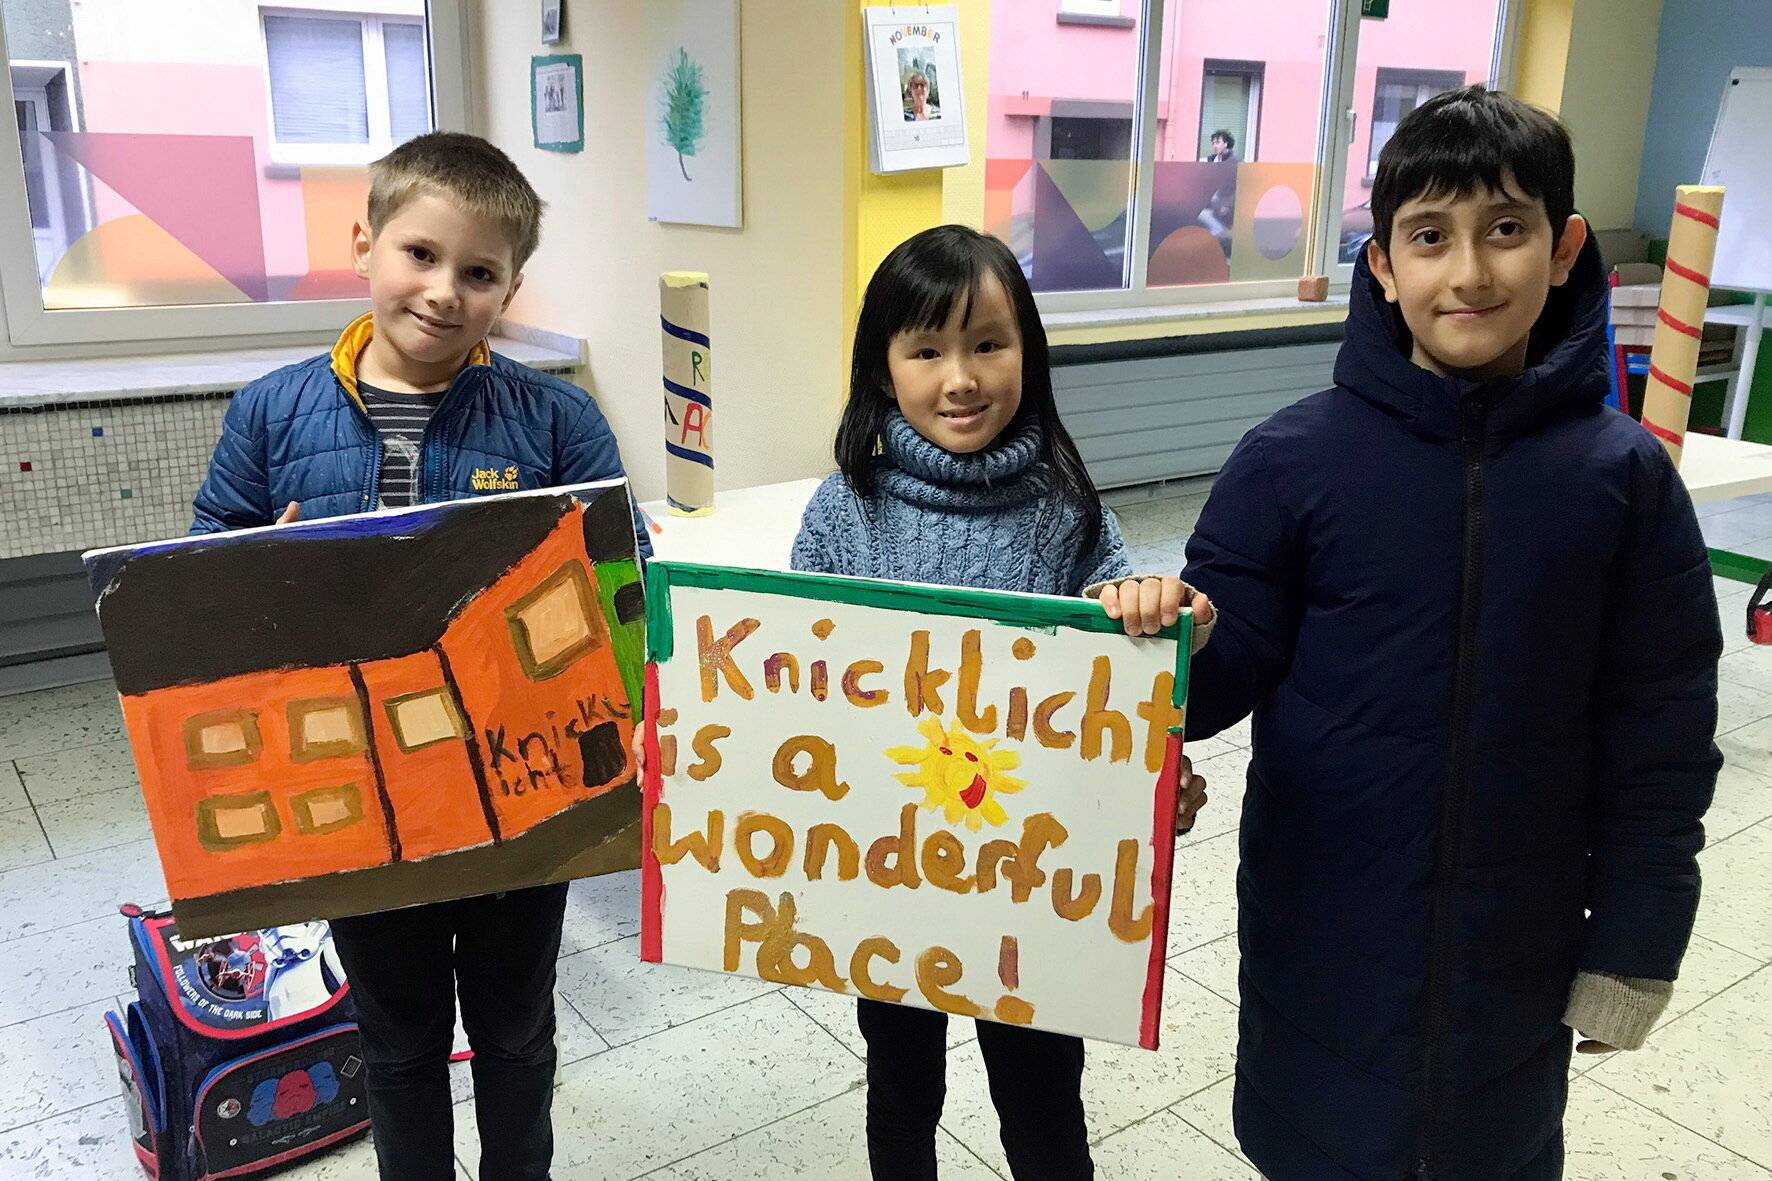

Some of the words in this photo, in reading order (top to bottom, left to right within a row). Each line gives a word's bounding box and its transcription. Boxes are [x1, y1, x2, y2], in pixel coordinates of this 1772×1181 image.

[889, 25, 941, 46] NOVEMBER
[471, 467, 500, 479] Jack
[471, 478, 519, 490] Wolfskin
[696, 615, 1184, 773] Knicklicht
[657, 707, 731, 782] is
[771, 734, 851, 801] a
[173, 964, 201, 1004] FOLLOWERS
[199, 998, 210, 1009] OF
[208, 1004, 224, 1016] THE
[223, 1009, 244, 1020] DARK
[245, 1009, 263, 1020] SIDE
